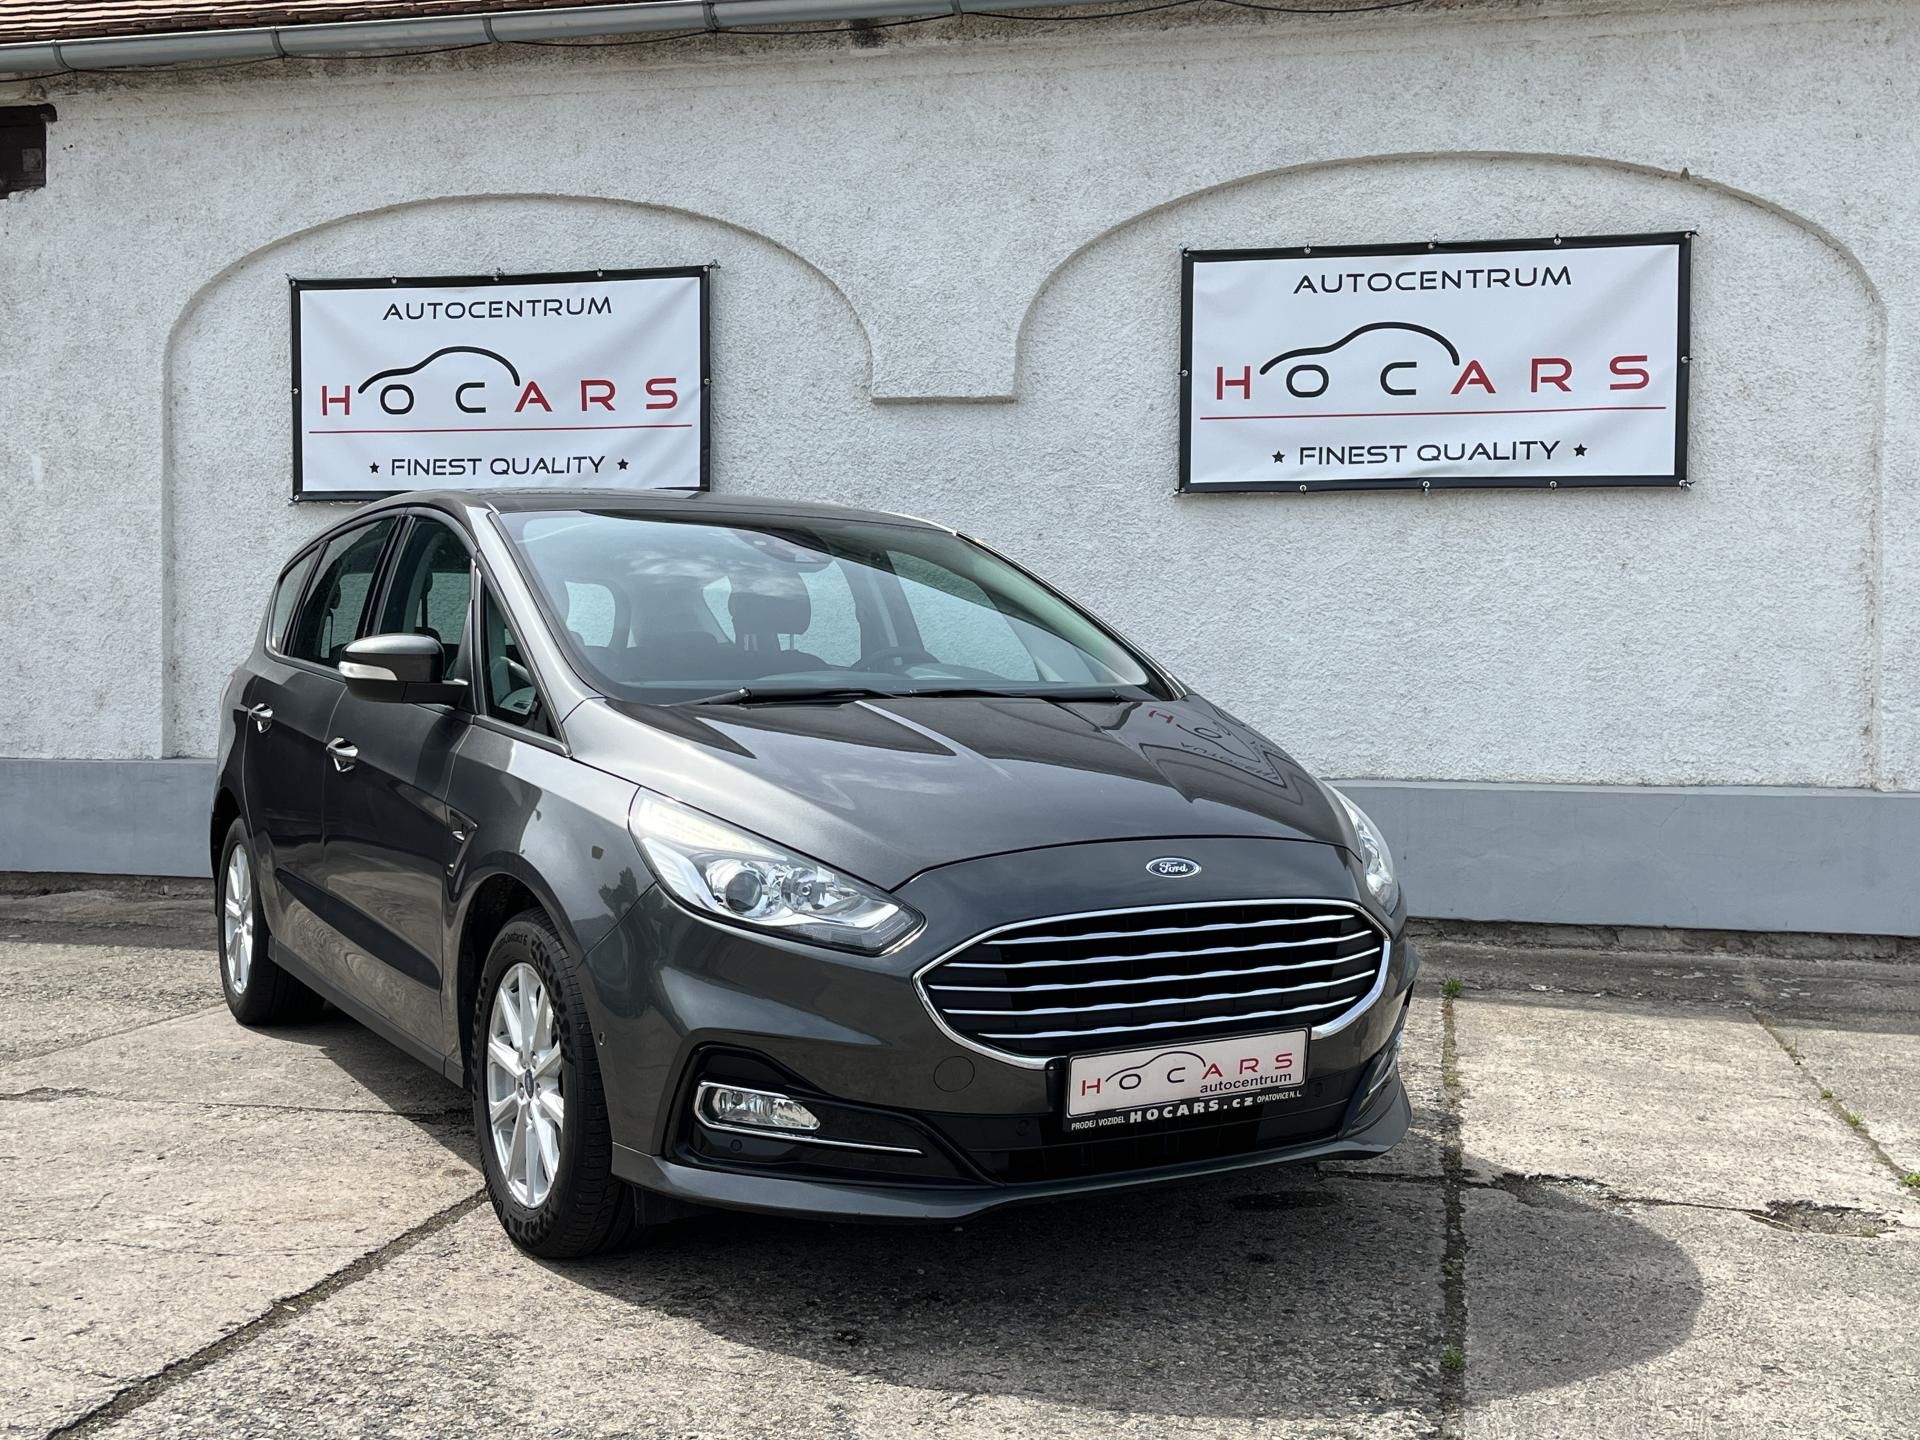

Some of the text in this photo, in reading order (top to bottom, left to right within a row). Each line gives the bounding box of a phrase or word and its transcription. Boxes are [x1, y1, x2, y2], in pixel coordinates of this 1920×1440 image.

[1293, 266, 1572, 295] AUTOCENTRUM
[382, 296, 612, 321] AUTOCENTRUM
[391, 455, 606, 476] FINEST QUALITY
[1299, 440, 1561, 466] FINEST QUALITY
[1160, 861, 1188, 874] Ford
[1200, 1073, 1292, 1094] autocentrum
[1071, 1119, 1097, 1131] PRODEJ
[1098, 1115, 1126, 1127] VOZIDEL
[1256, 1091, 1289, 1103] OPATOVICE
